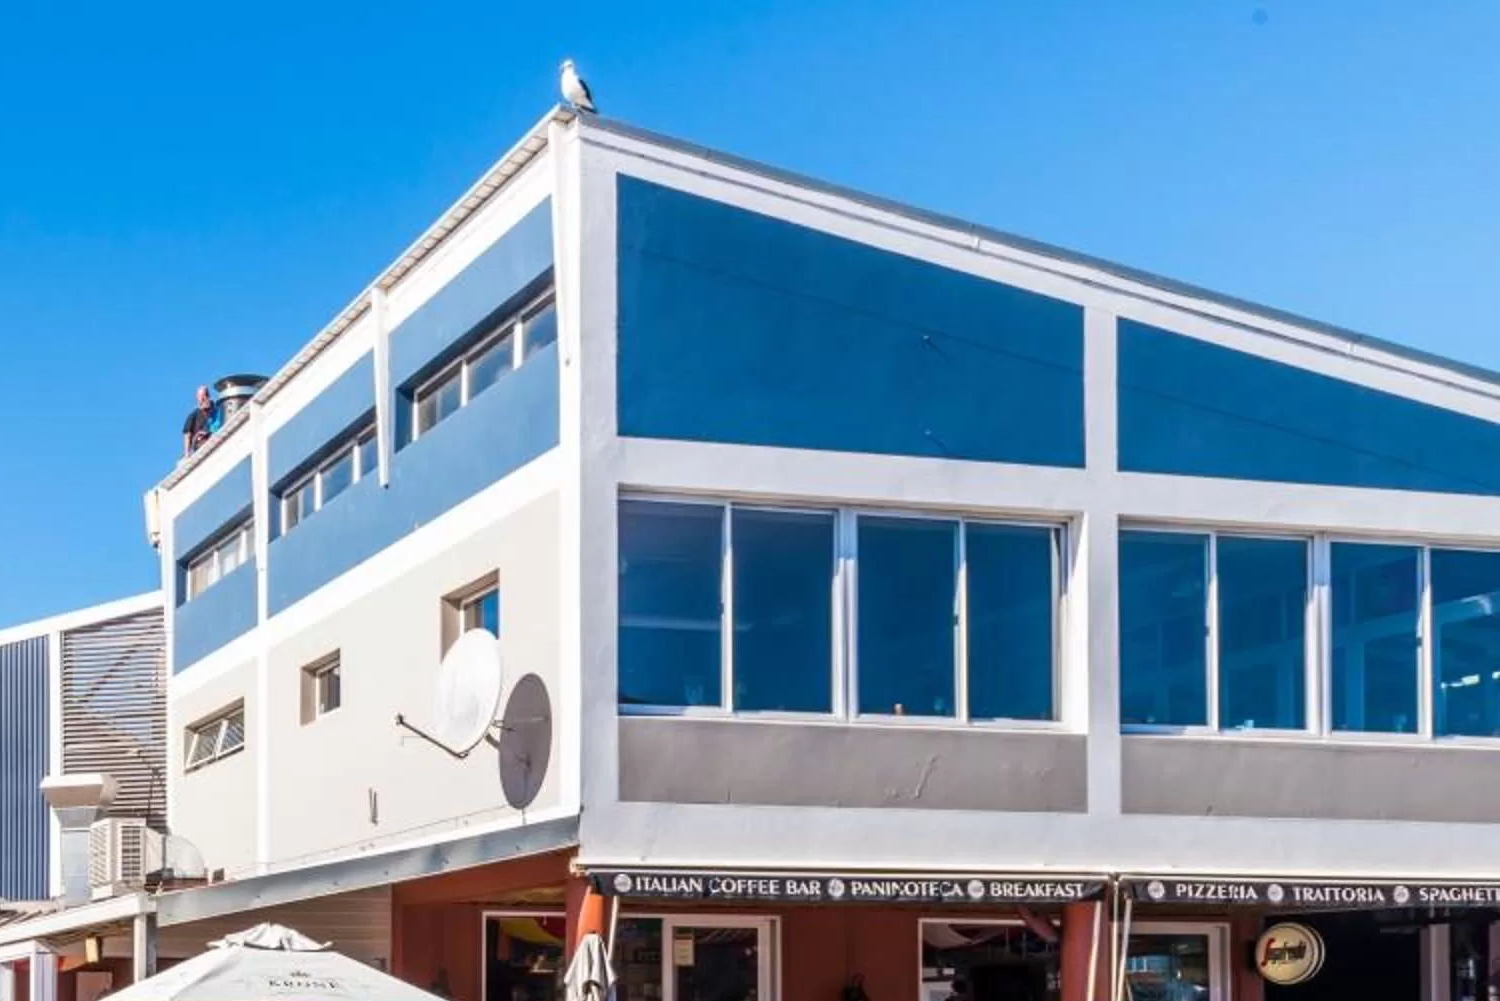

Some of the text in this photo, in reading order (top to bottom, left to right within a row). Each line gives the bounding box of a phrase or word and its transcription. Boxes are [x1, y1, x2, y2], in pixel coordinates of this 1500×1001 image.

[635, 875, 821, 895] ITALIAN COFFEE BAR
[990, 882, 1085, 898] BREAKFAST
[1175, 883, 1258, 900] PIZZERIA
[1292, 886, 1385, 902] TRATTORIA
